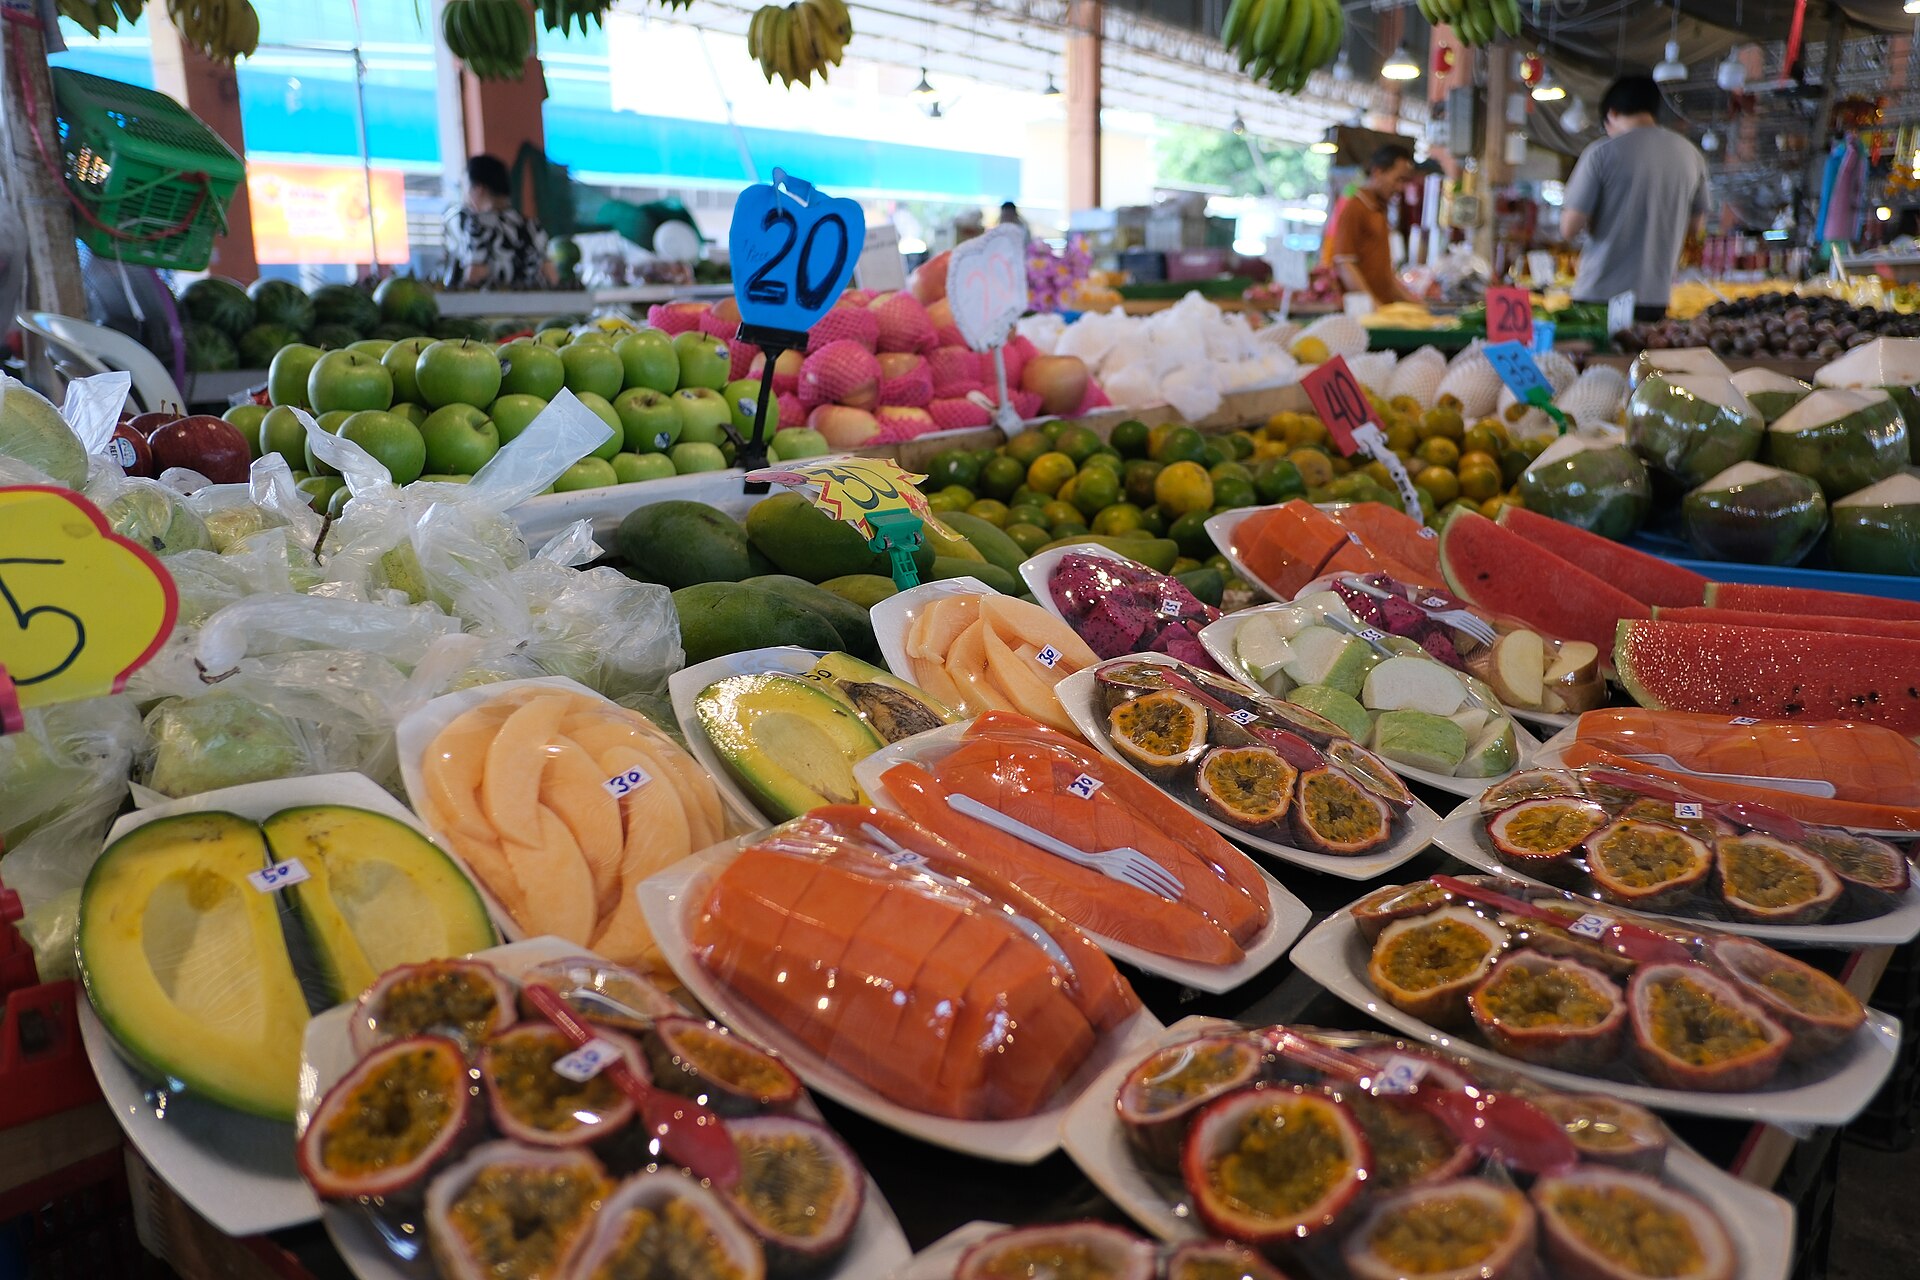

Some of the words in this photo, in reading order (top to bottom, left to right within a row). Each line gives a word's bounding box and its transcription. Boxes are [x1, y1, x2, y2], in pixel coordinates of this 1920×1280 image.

[744, 209, 848, 310] 20
[1498, 295, 1529, 333] 20
[1323, 370, 1368, 429] 40
[809, 465, 899, 511] 30
[1038, 649, 1054, 665] 30
[797, 669, 832, 681] 50
[610, 771, 640, 793] 30
[1070, 777, 1093, 796] 30
[262, 866, 288, 883] 50
[1574, 917, 1602, 933] 30
